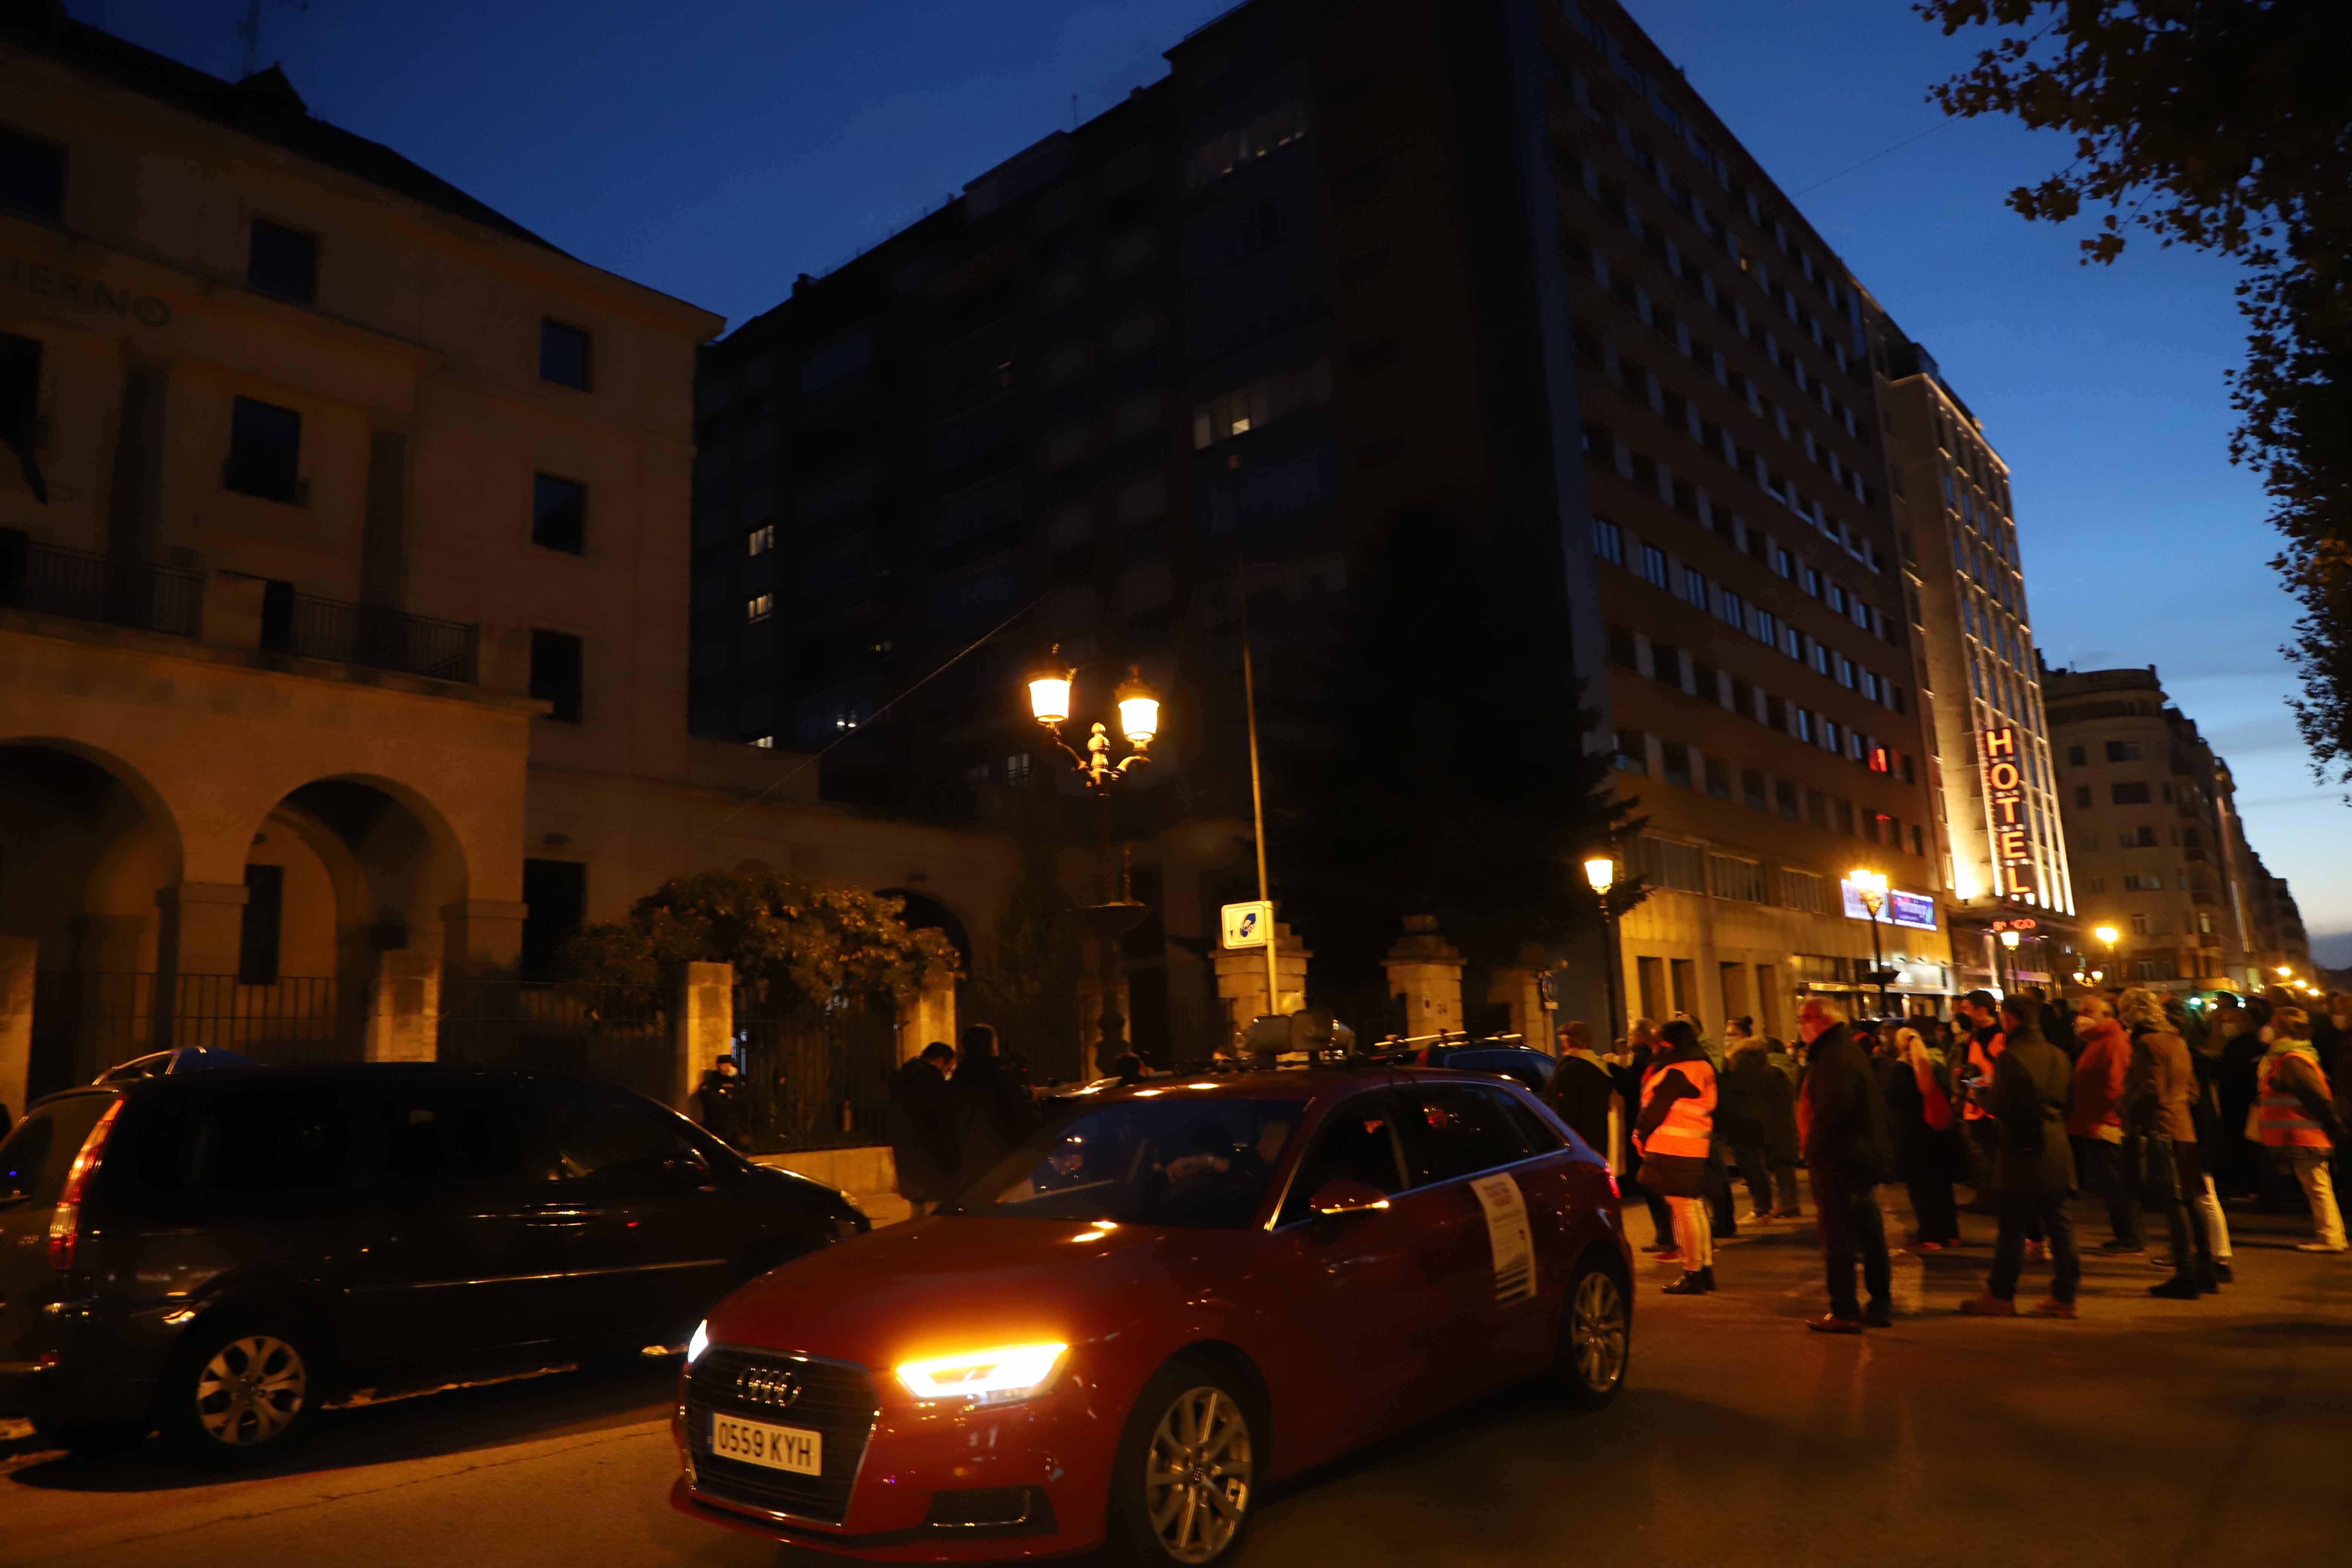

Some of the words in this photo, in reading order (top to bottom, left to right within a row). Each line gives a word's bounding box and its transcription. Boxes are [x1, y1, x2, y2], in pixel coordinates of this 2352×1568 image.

[0, 256, 172, 328] IERNO
[1986, 728, 2031, 893] HOTEL
[718, 1422, 765, 1457] 0559
[770, 1433, 812, 1467] KYH
